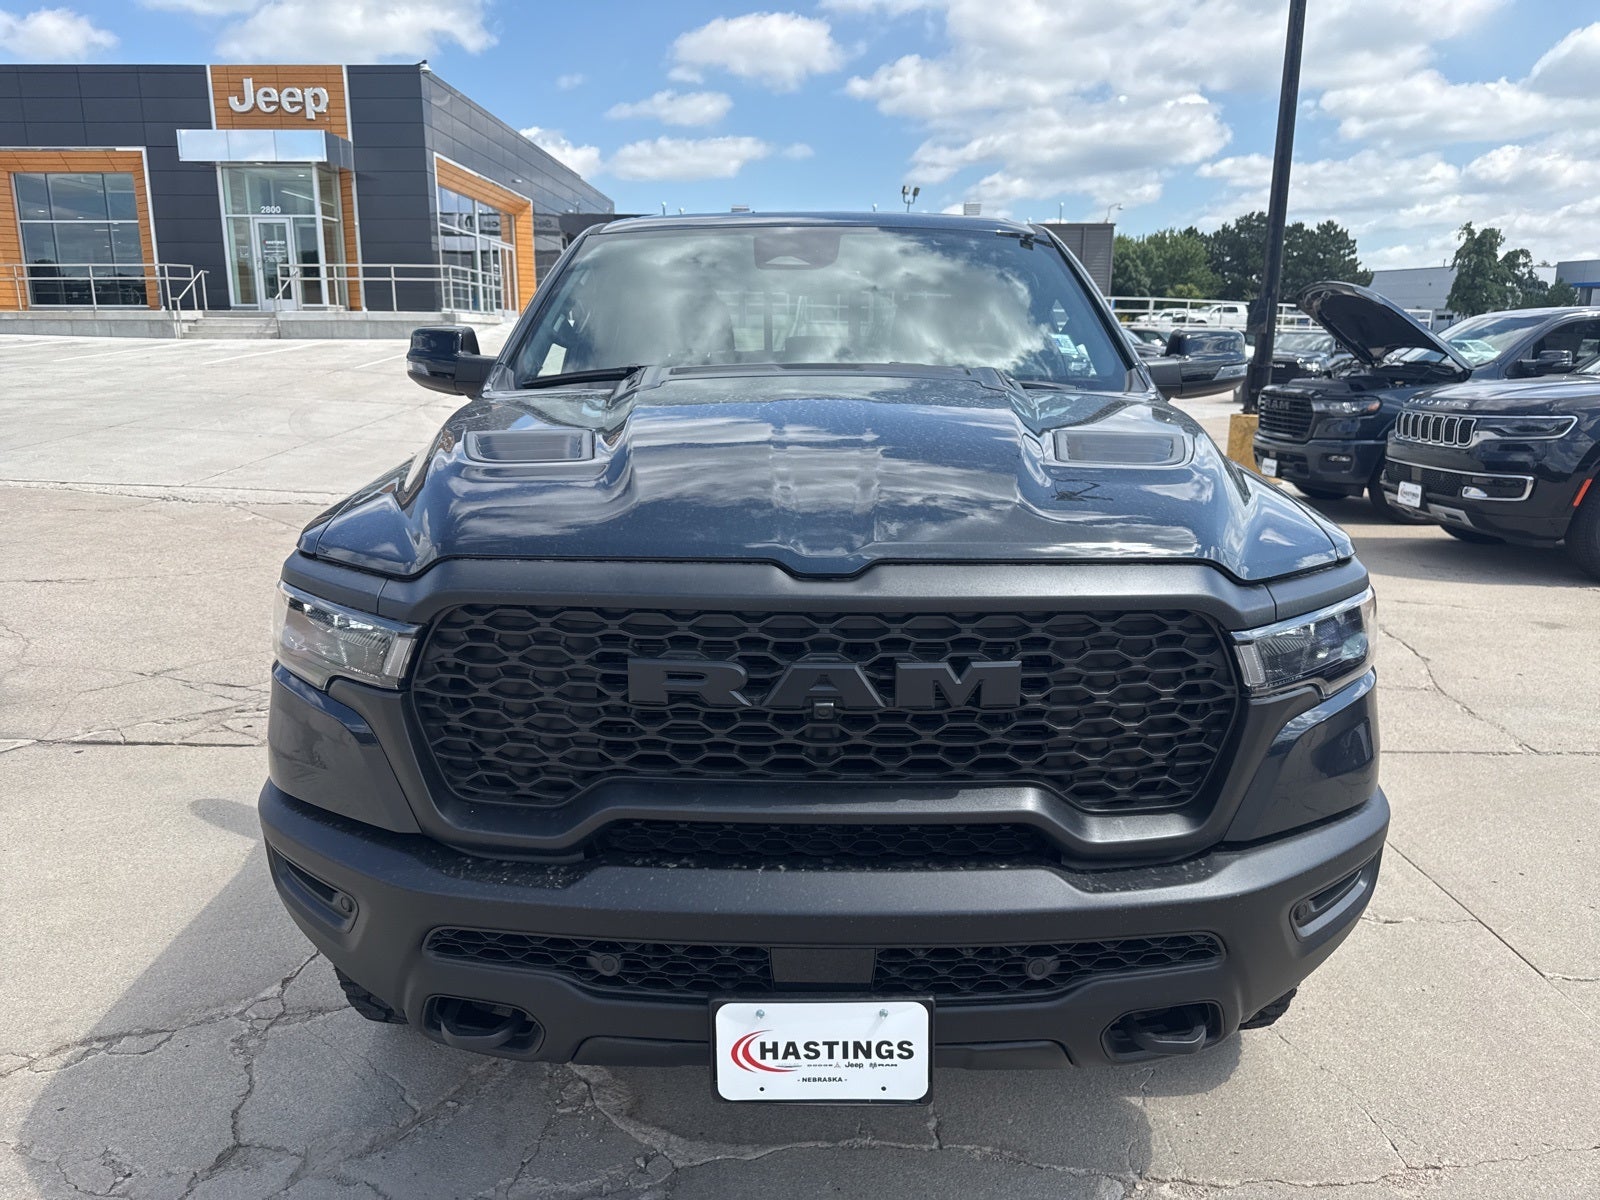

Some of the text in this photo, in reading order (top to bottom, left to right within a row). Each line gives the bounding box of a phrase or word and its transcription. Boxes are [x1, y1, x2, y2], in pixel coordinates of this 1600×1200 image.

[228, 77, 329, 120] Jeep
[260, 205, 281, 214] 2800
[628, 658, 1022, 708] RAM
[759, 1040, 915, 1060] HASTINGS
[844, 1061, 864, 1069] Jeep
